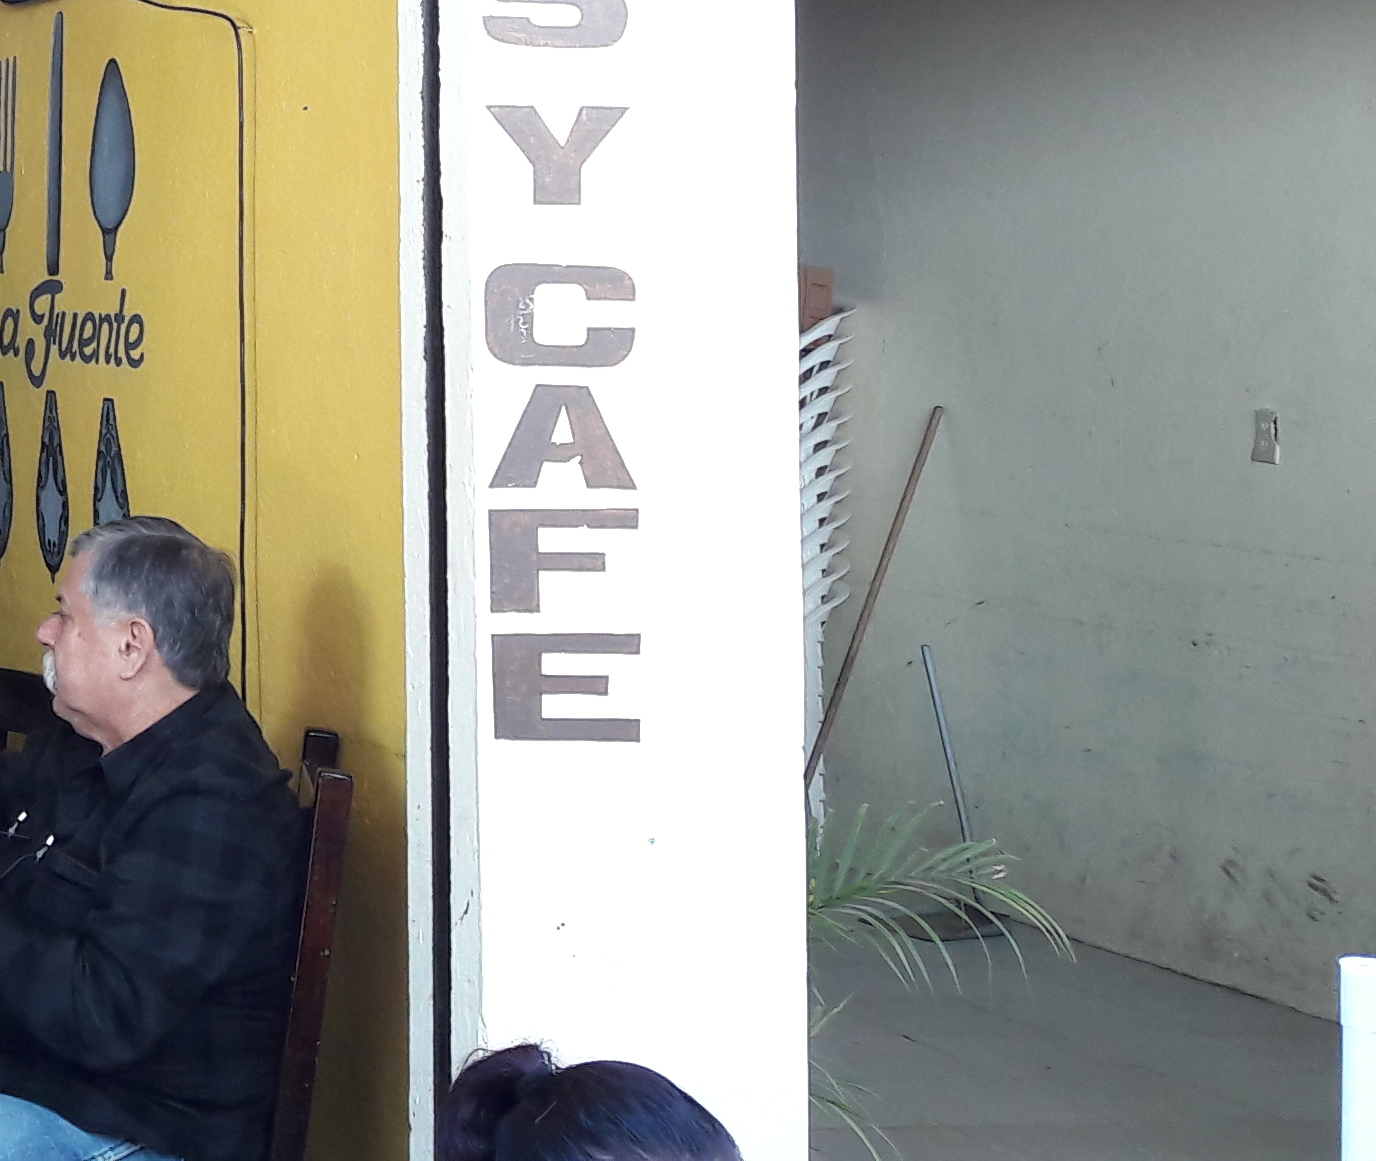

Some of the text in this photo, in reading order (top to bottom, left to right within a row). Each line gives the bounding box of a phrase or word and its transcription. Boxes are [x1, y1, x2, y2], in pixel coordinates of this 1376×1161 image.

[484, 105, 631, 205] Y
[24, 279, 145, 389] Fuente
[483, 262, 642, 743] CAFE
